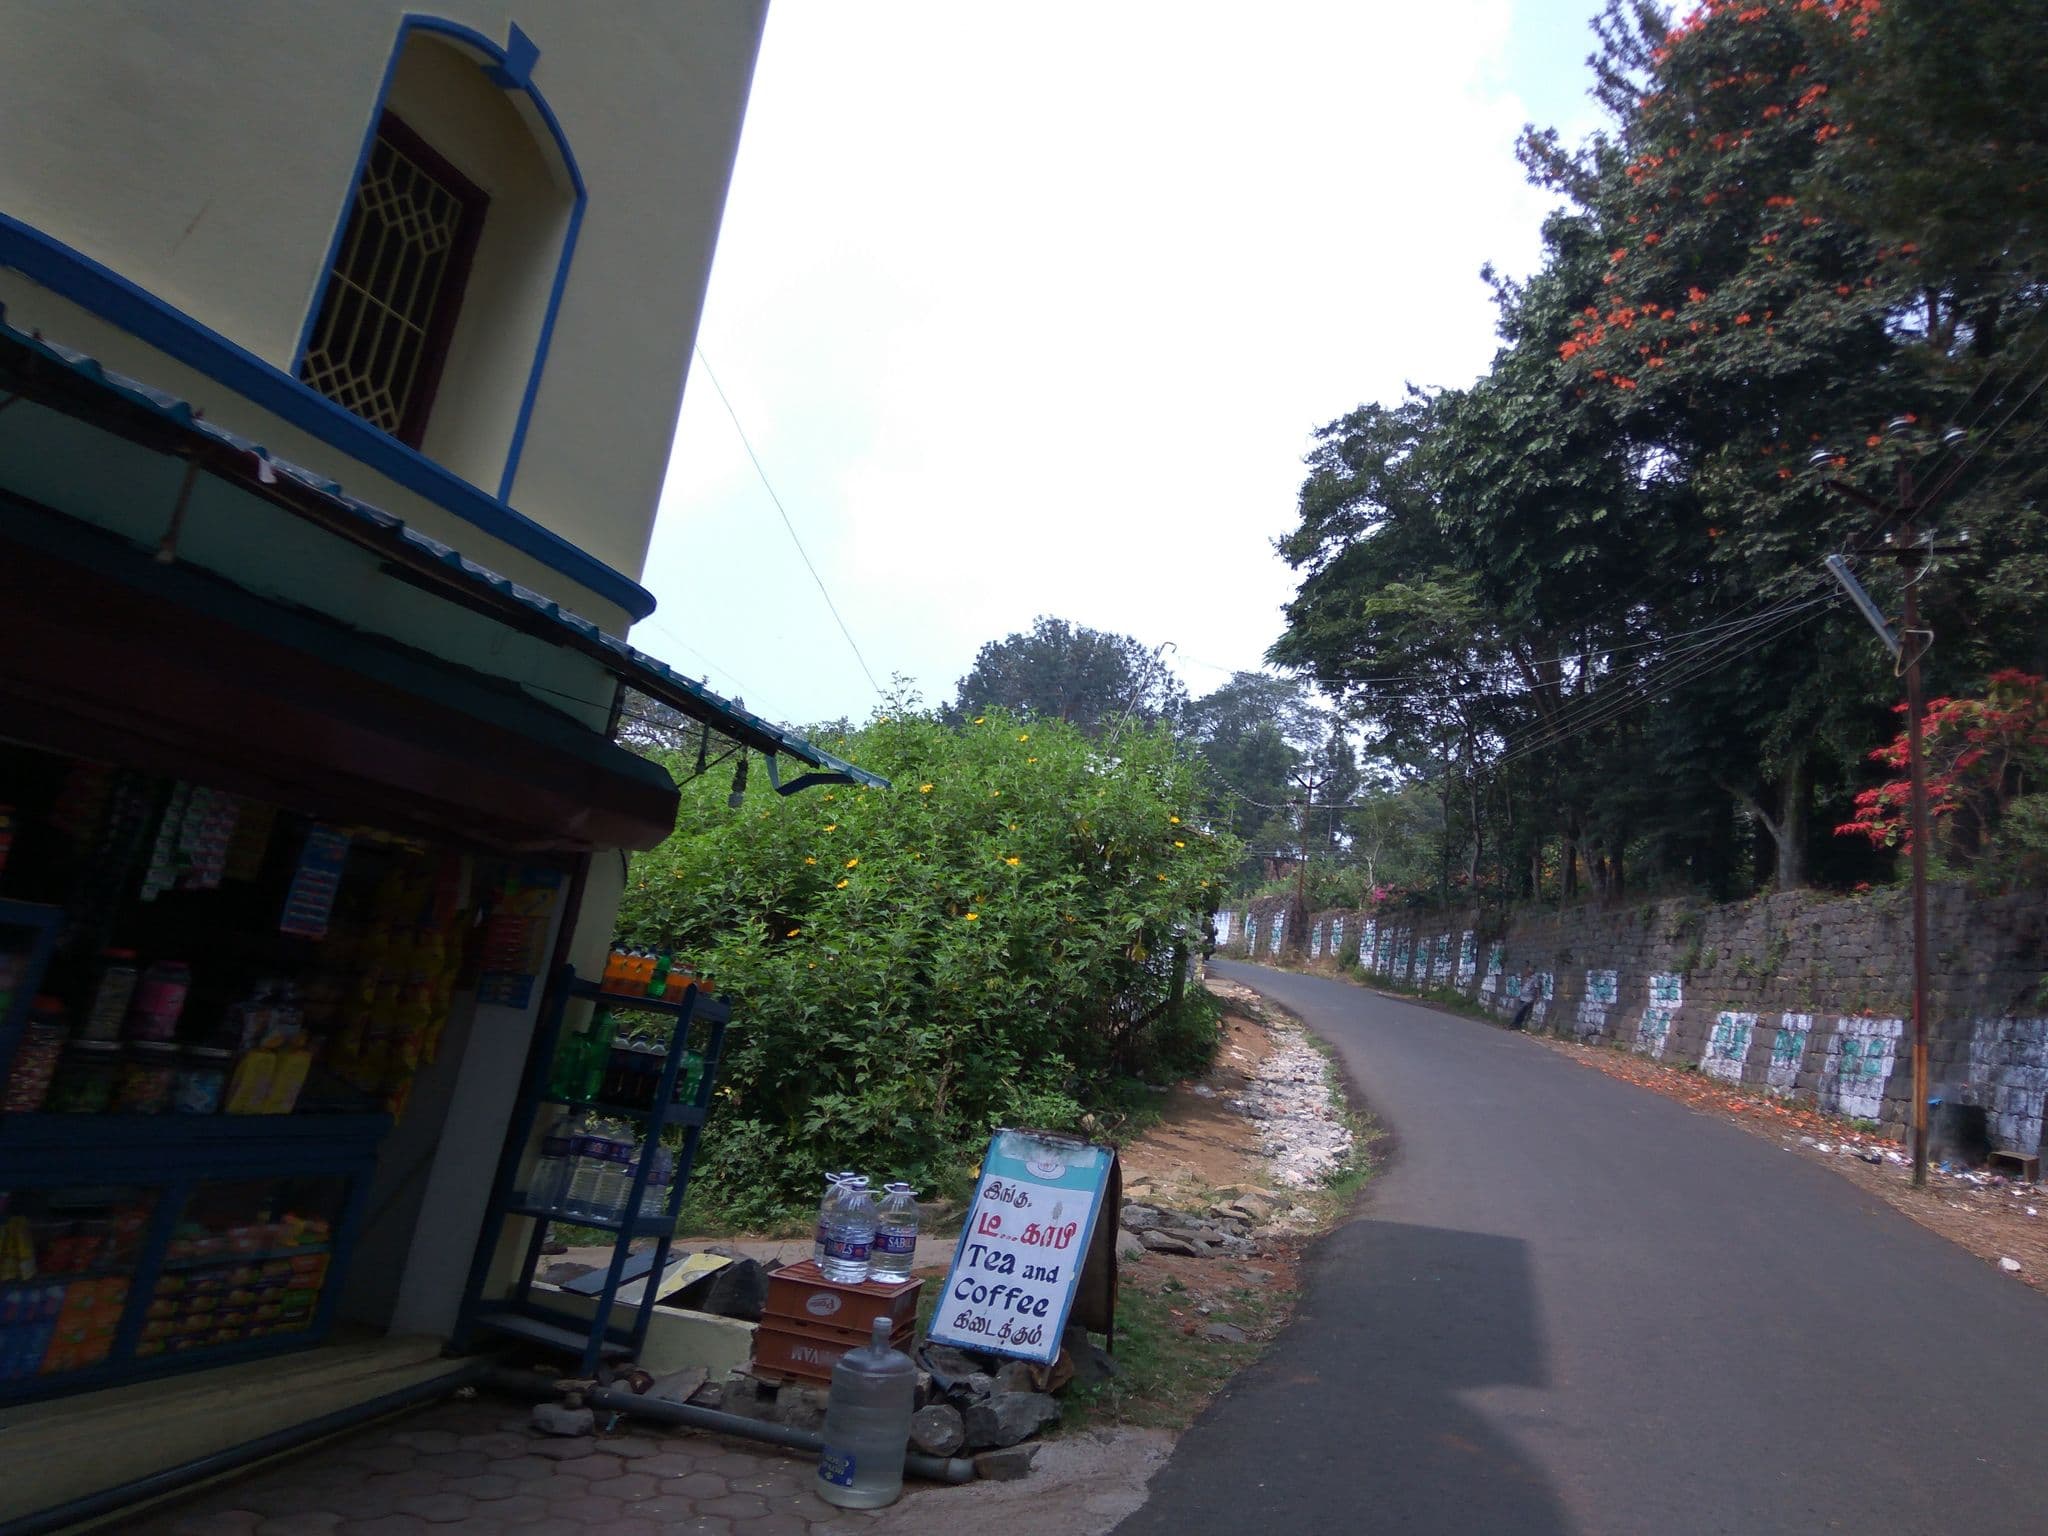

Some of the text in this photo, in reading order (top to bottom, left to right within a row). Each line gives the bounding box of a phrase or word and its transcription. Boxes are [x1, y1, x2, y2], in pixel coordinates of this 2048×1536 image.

[968, 1244, 1060, 1284] Tea and
[954, 1277, 1050, 1318] Coffee
